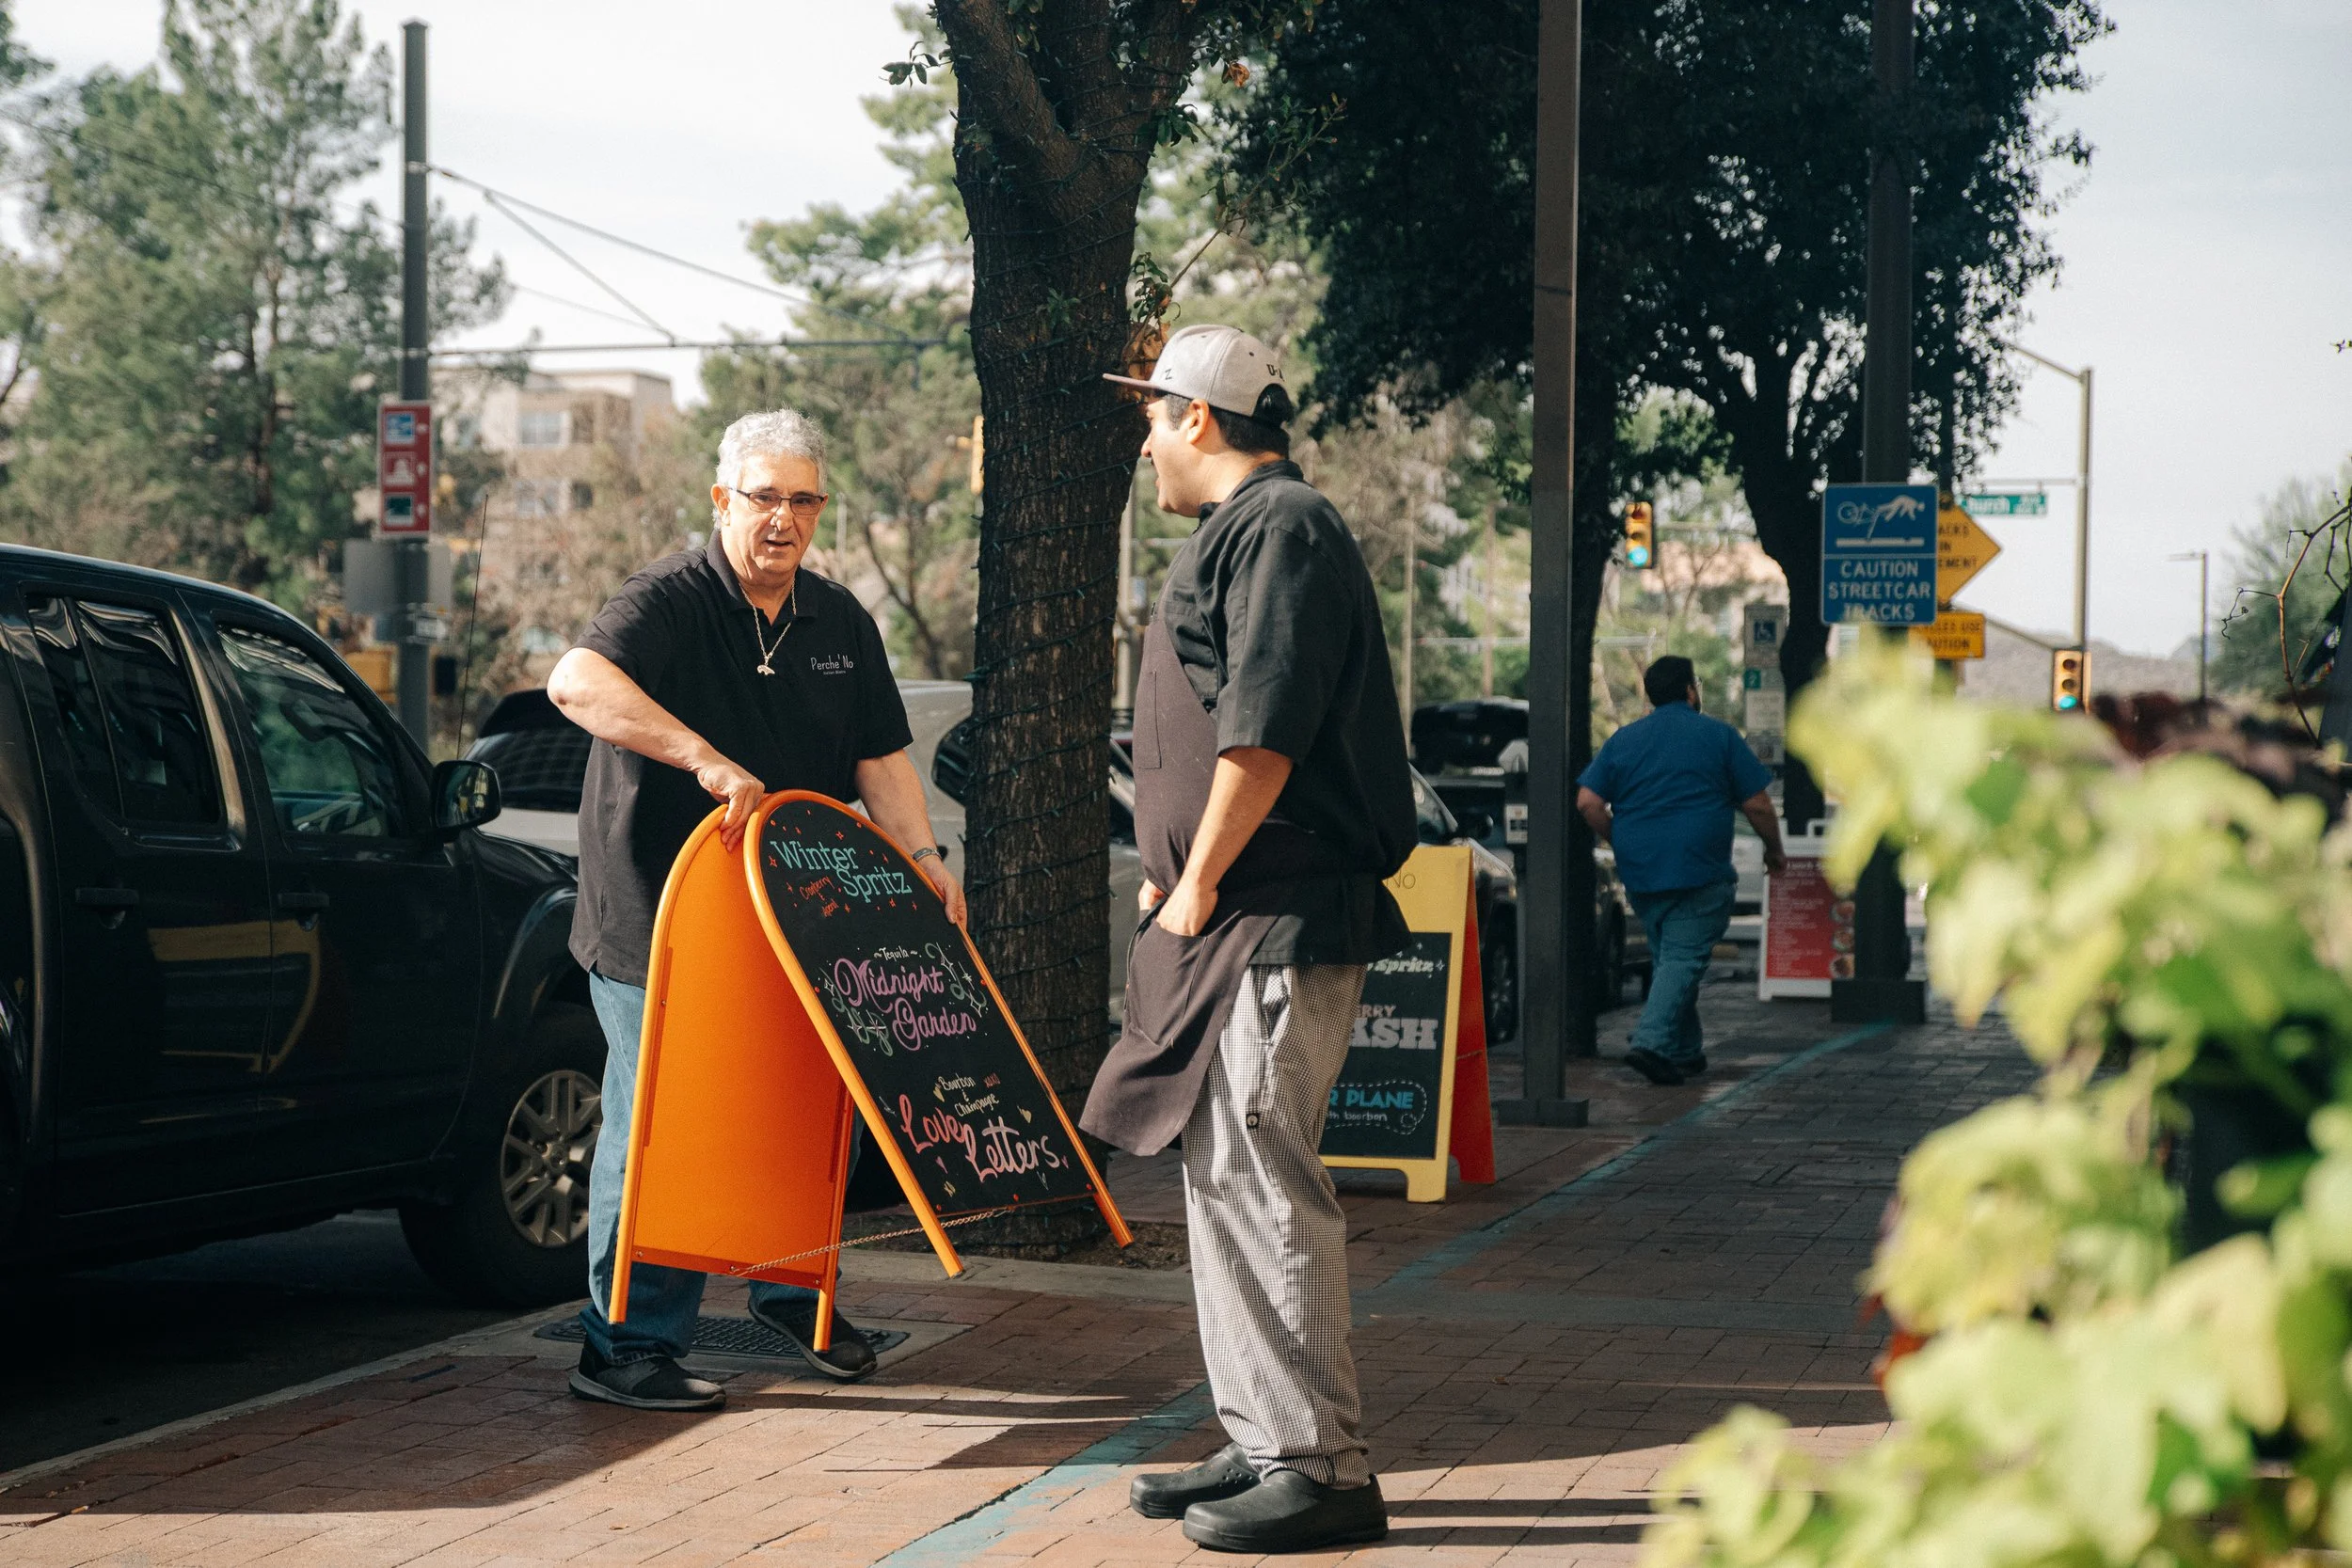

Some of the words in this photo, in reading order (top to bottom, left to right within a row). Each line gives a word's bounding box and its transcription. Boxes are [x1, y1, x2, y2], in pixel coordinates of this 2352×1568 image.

[1841, 560, 1918, 578] CAUTION
[1828, 581, 1931, 600] STREETCAR
[843, 655, 854, 669] No
[770, 840, 859, 870] Winter
[836, 865, 913, 903] Spritz
[834, 958, 945, 1014] Midnight
[892, 997, 977, 1051] Garden
[1350, 1017, 1438, 1050] ASH
[938, 1072, 976, 1091] Bourbon
[1345, 1089, 1415, 1109] PLANE
[898, 1094, 965, 1154] Love
[1344, 1111, 1388, 1121] bourbon
[961, 1116, 1060, 1182] Letters
